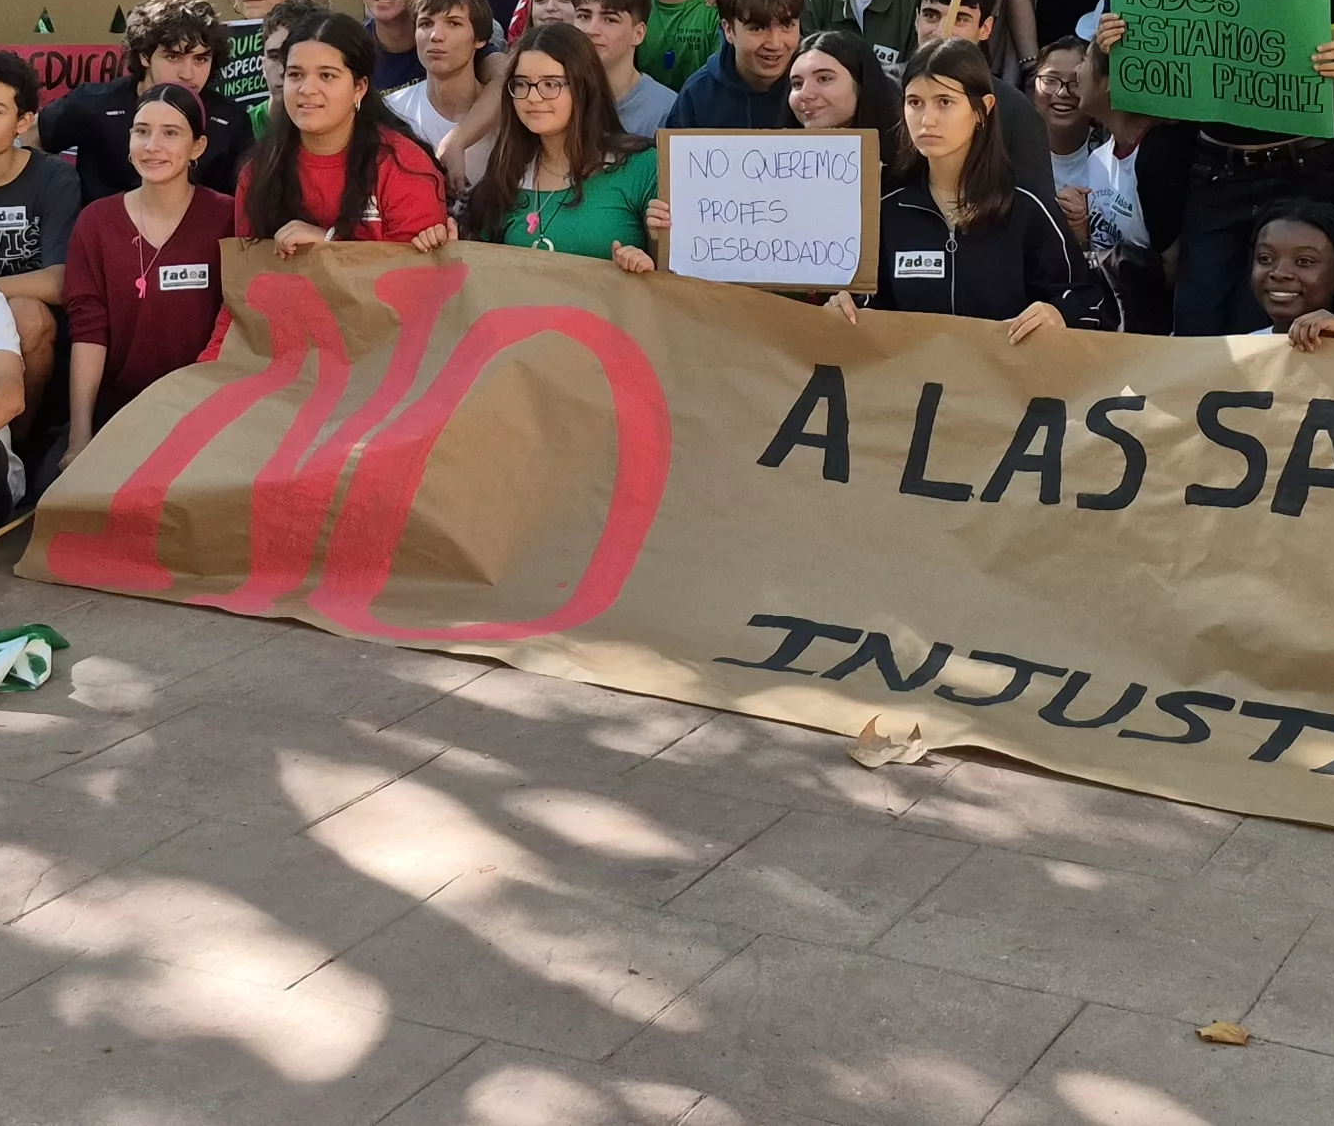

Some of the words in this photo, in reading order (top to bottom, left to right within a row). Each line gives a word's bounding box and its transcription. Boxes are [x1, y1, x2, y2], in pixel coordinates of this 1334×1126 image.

[1120, 12, 1286, 68] ESTAMOS
[224, 74, 268, 97] INSPECC
[1120, 56, 1192, 98] CON
[1214, 63, 1326, 113] PICHI
[689, 149, 729, 179] NO
[742, 149, 859, 184] QUEREMOS
[698, 198, 788, 224] PROFES
[691, 236, 857, 270] DESBORDADOS
[898, 256, 943, 269] fadea
[163, 270, 207, 281] fadea
[46, 264, 672, 641] NO
[757, 364, 850, 483] A
[900, 382, 1147, 510] LAS
